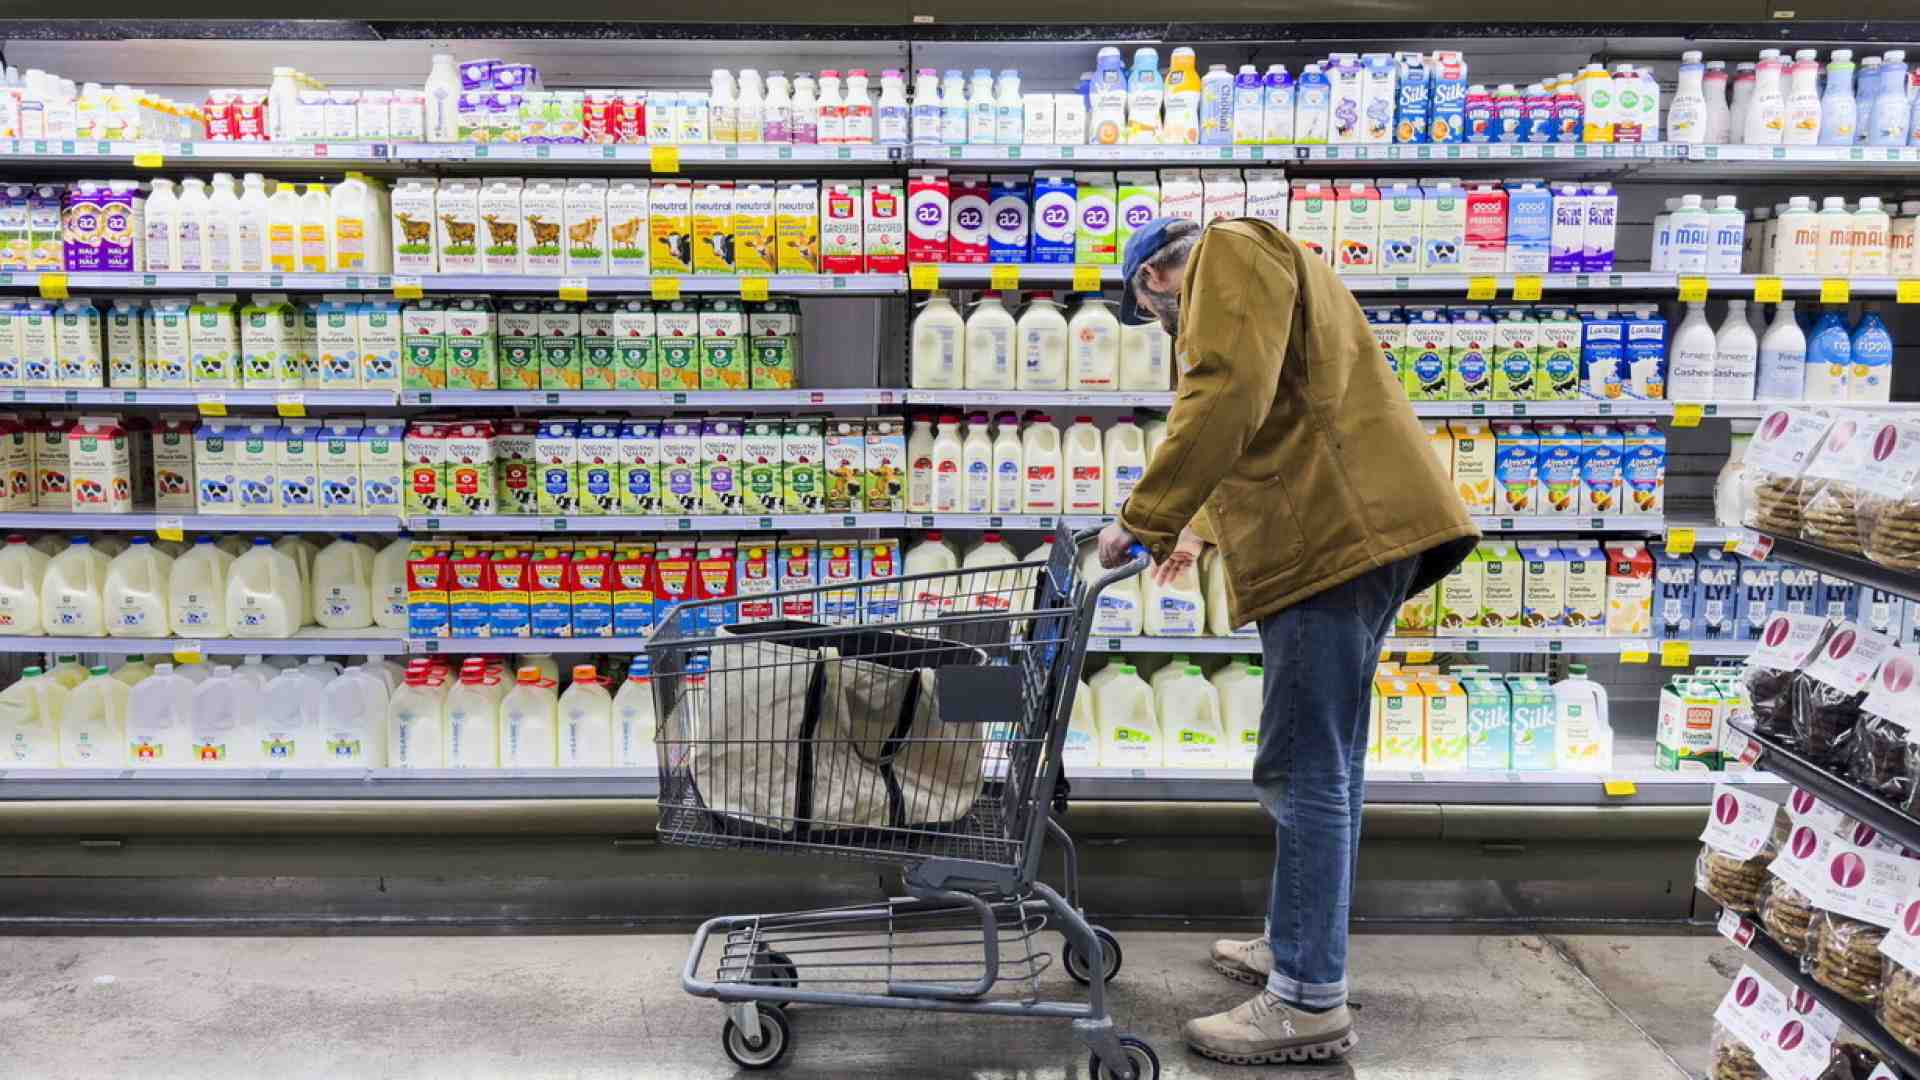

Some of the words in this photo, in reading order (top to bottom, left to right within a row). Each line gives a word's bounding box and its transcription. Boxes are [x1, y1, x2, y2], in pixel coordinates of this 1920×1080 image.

[1401, 84, 1428, 102] Silk
[1435, 84, 1466, 102] Silk
[651, 201, 688, 210] neutral
[695, 202, 731, 211] neutral
[736, 201, 772, 210] neutral
[778, 202, 814, 211] neutral
[1472, 203, 1500, 213] good
[918, 208, 940, 221] a2
[960, 212, 982, 225] a2
[998, 212, 1020, 226] a2
[1046, 209, 1068, 224] a2
[1086, 211, 1108, 225] a2
[1127, 210, 1150, 224] a2
[1557, 217, 1580, 226] Milk
[1589, 217, 1613, 226] Milk
[80, 218, 95, 229] a2
[110, 218, 125, 229] a2
[1663, 584, 1690, 598] LY!
[1705, 584, 1730, 600] LY!
[1747, 585, 1773, 600] LY!
[1786, 586, 1812, 600] LY!
[1826, 586, 1852, 601] LY!
[1469, 707, 1510, 731] Silk
[1515, 707, 1555, 729] Silk
